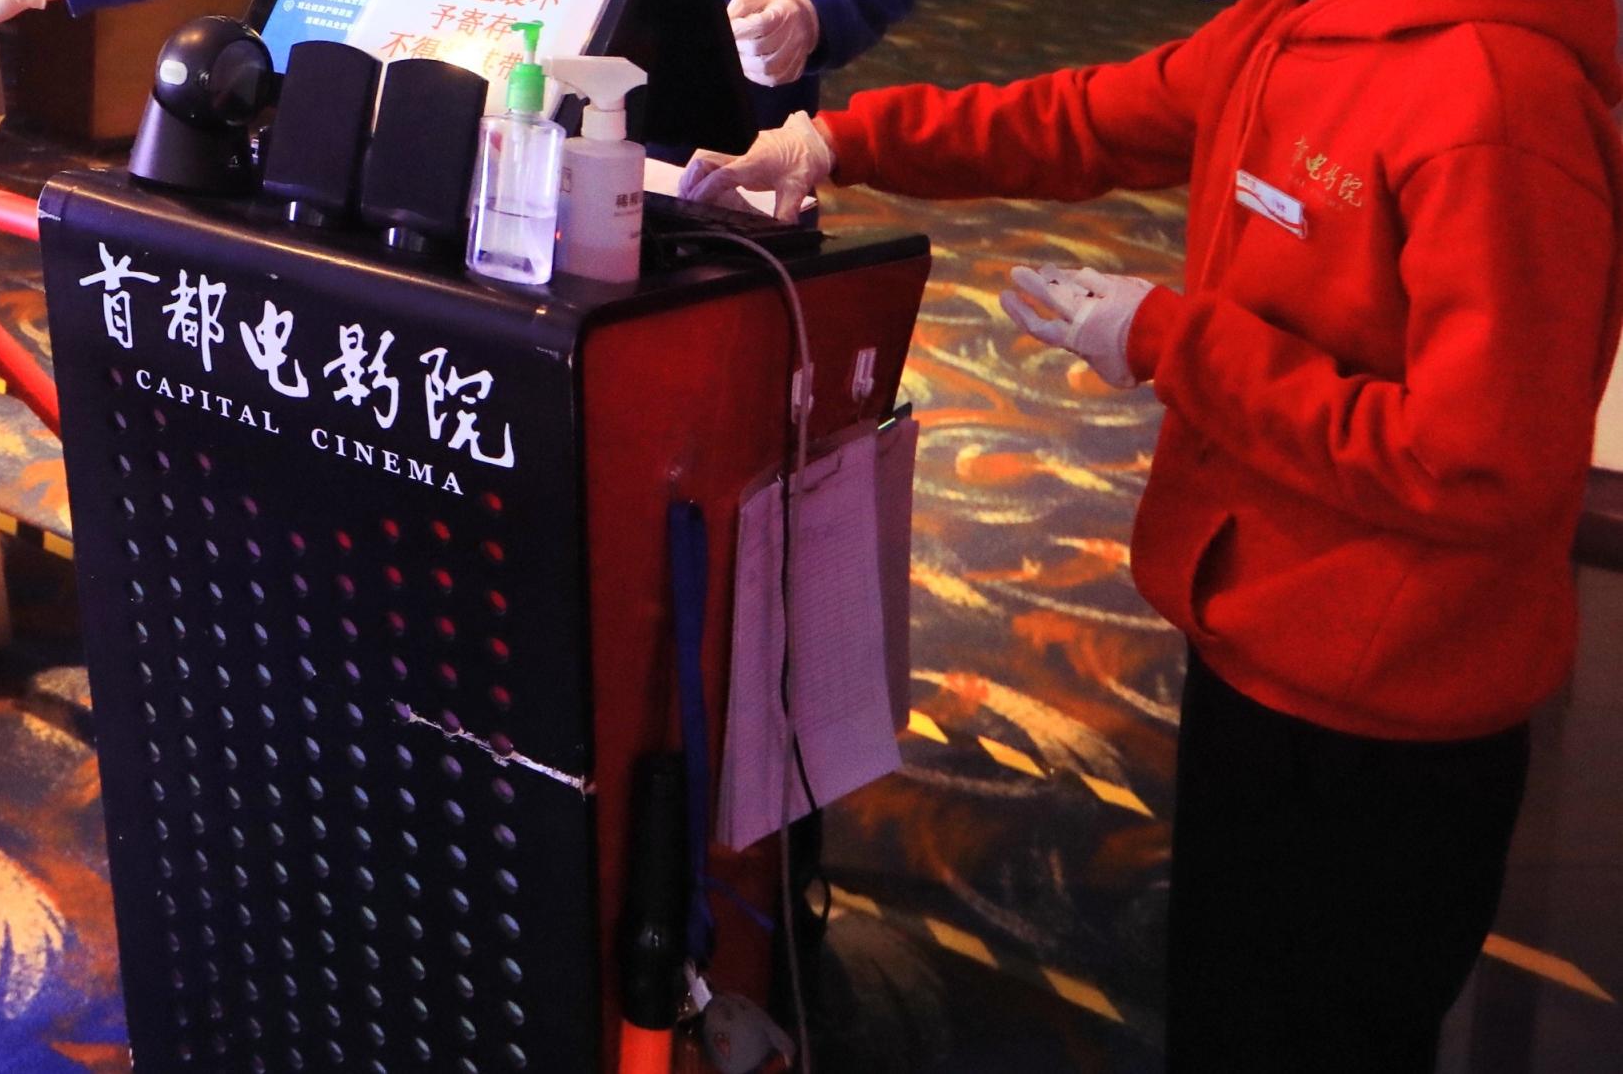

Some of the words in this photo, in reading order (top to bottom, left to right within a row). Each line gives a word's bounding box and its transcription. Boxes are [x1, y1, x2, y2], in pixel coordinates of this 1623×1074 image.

[430, 3, 519, 41] 予寄存
[79, 242, 516, 469] 首都电影院
[135, 368, 280, 435] CAPITAL
[311, 428, 465, 496] CINEMA
